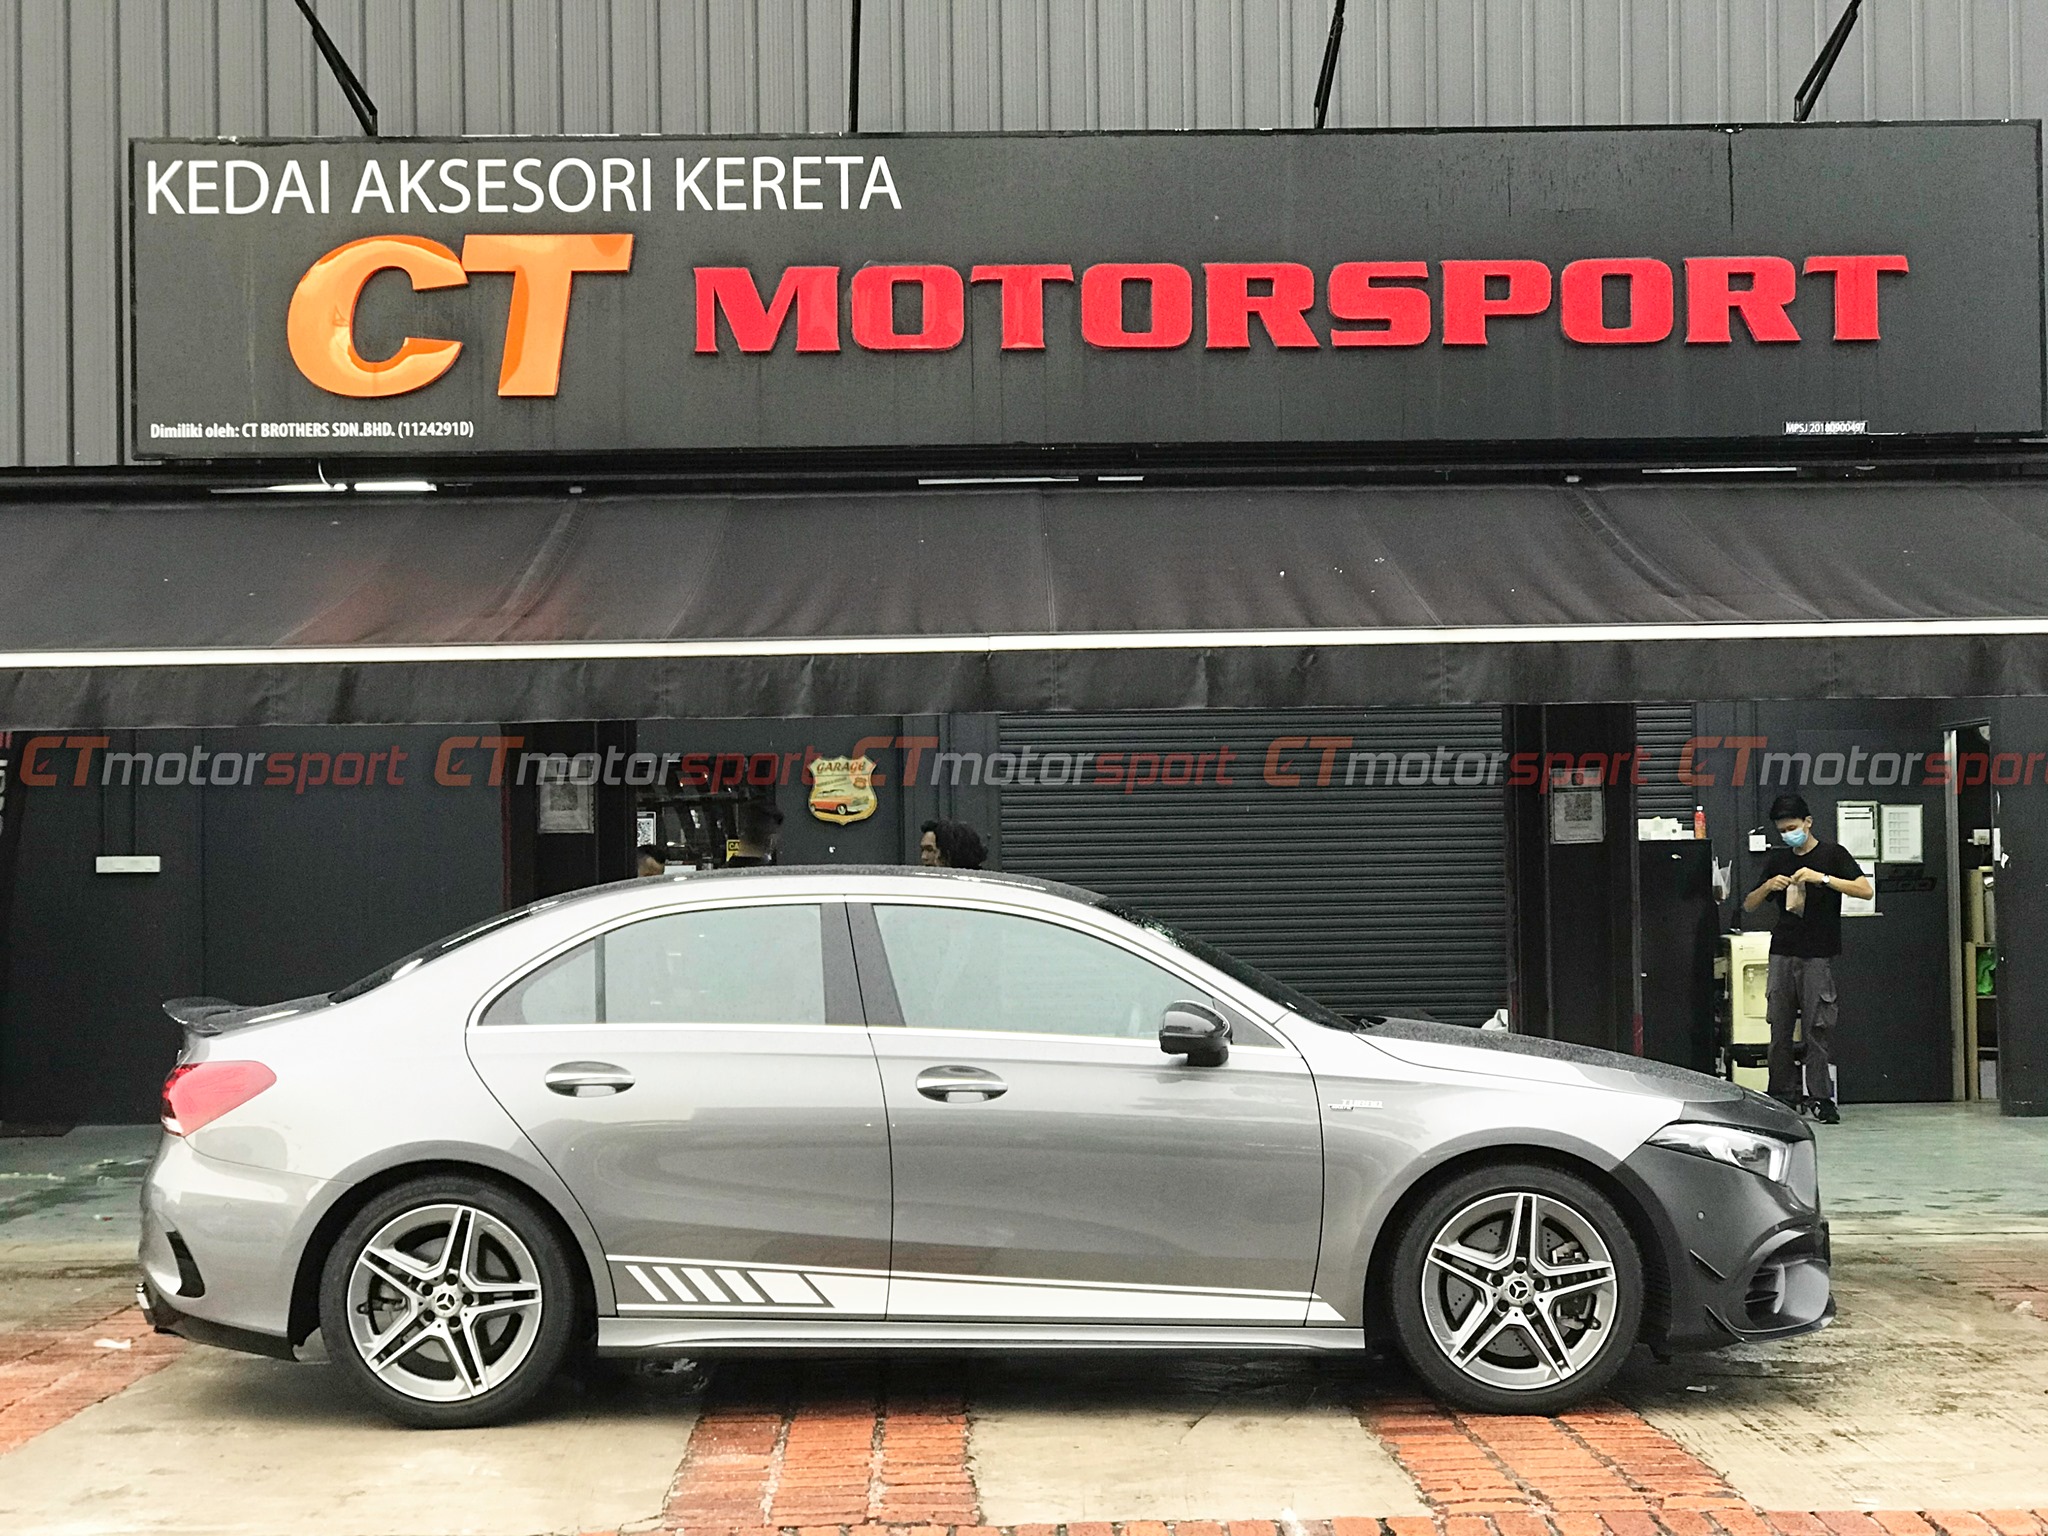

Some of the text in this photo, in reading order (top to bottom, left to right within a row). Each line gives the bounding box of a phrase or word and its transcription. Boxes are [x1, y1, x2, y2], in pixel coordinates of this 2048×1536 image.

[146, 155, 903, 215] KEDAI AKSESORI KERETA
[286, 233, 1911, 398] CT MOTORSPORT
[150, 423, 203, 438] Dimiliki
[205, 422, 240, 438] oleh:
[242, 423, 258, 438] CT
[260, 422, 330, 438] BROTHERS
[398, 421, 475, 438] (1124291D)
[1786, 421, 1808, 433] MPSJ
